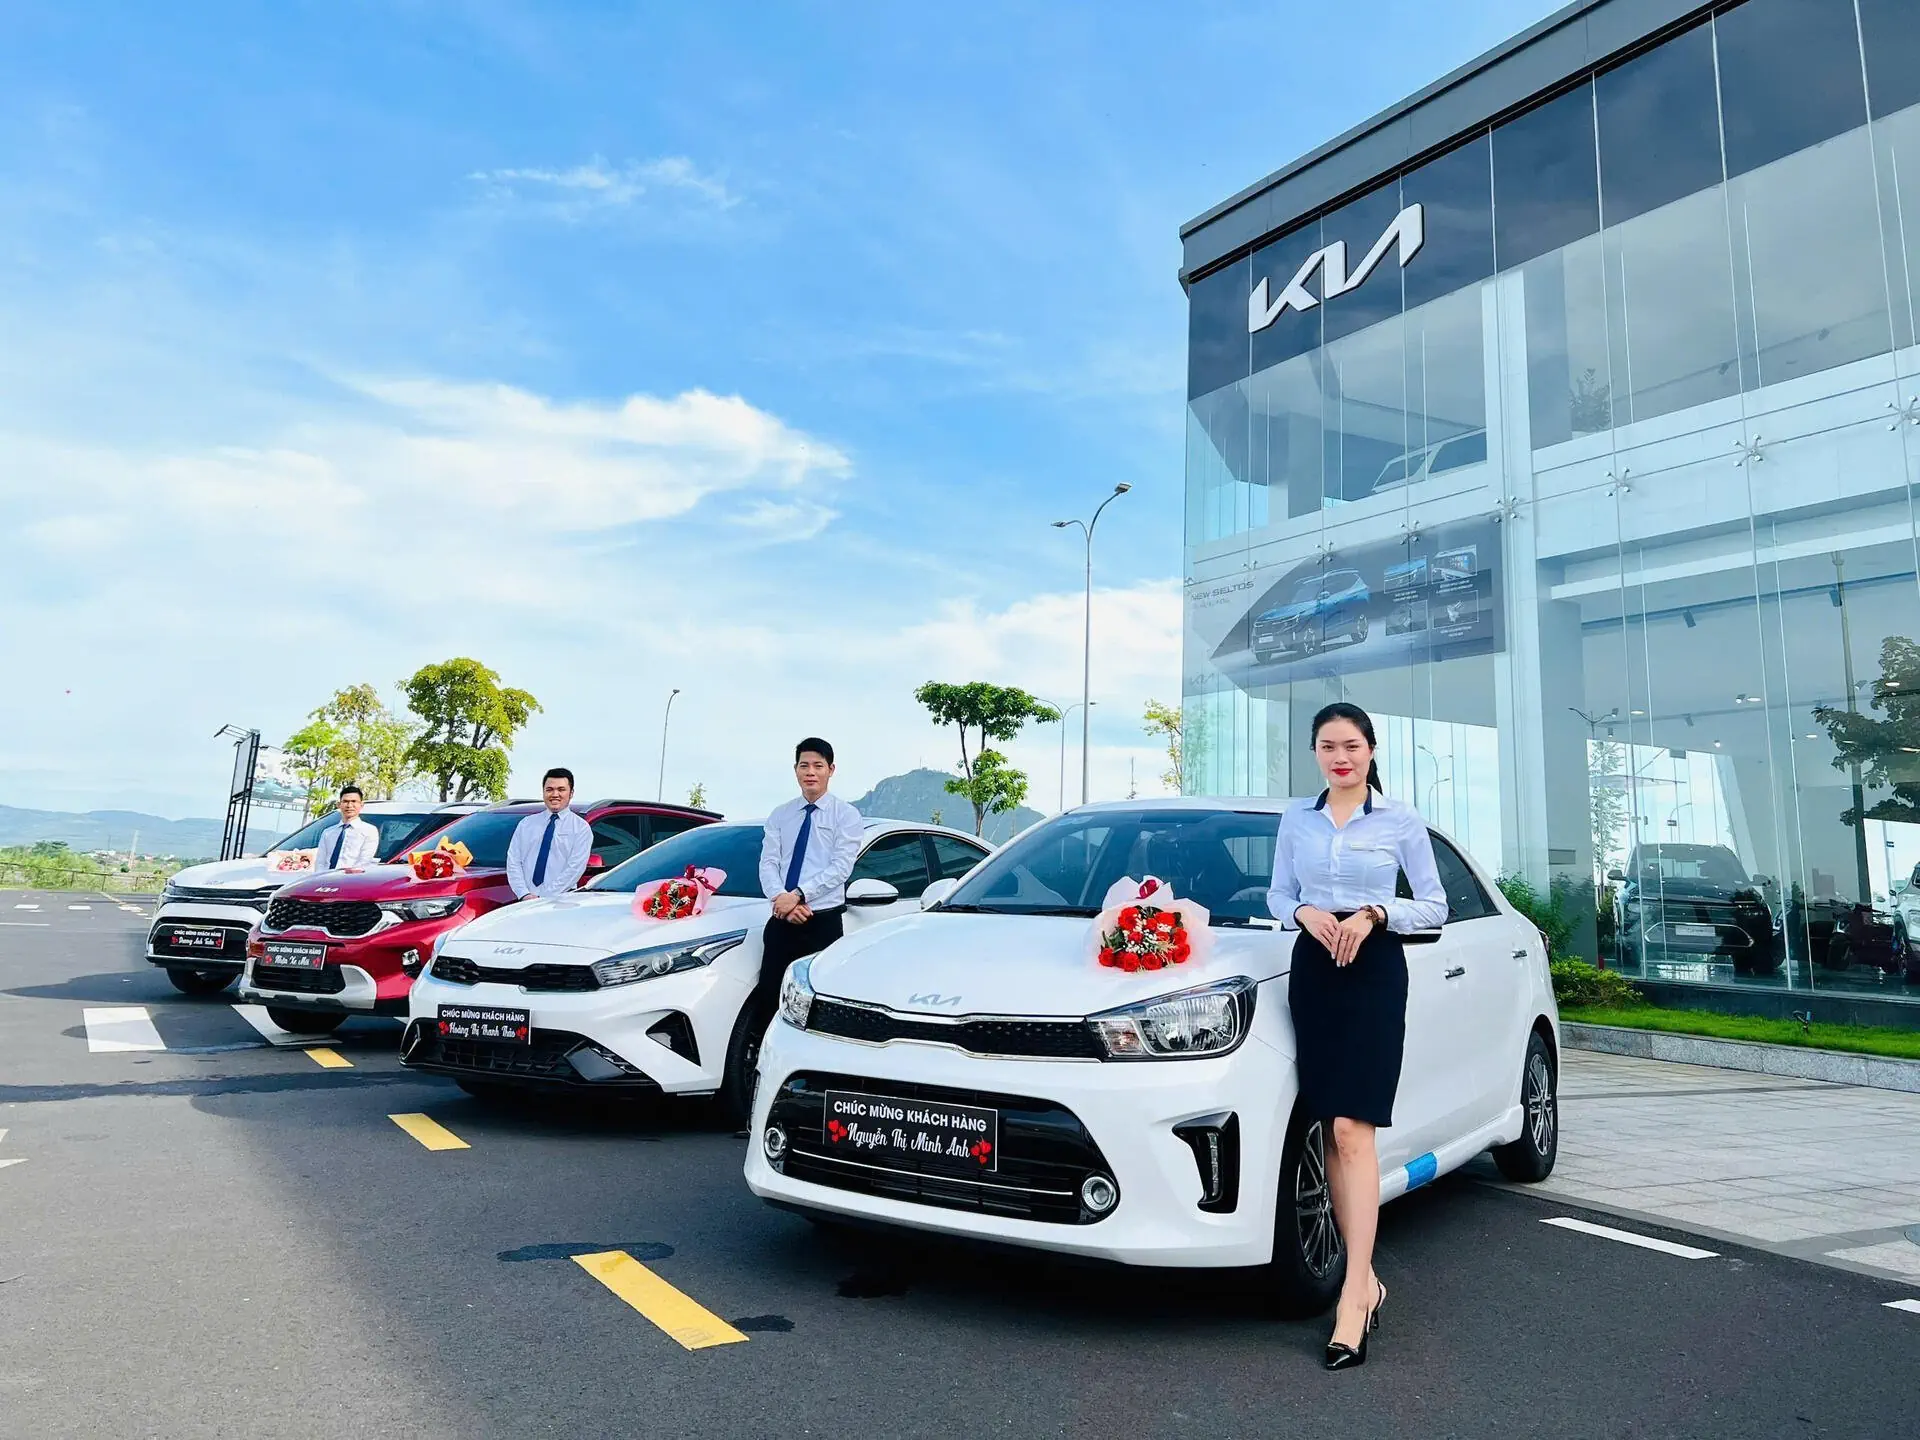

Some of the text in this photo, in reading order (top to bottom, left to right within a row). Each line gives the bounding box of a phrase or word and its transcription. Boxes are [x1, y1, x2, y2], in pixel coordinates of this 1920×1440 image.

[1248, 203, 1424, 333] KIA
[1211, 580, 1255, 596] SELTOS
[493, 947, 526, 955] KIA
[908, 993, 962, 1006] KIA
[441, 1008, 525, 1022] CHÚC MỪNG KHÁCH HÀNG
[833, 1100, 987, 1132] CHÚC MỪNG KHÁCH HÀNG
[847, 1122, 970, 1158] Nguyễn Thị Minh Anh
